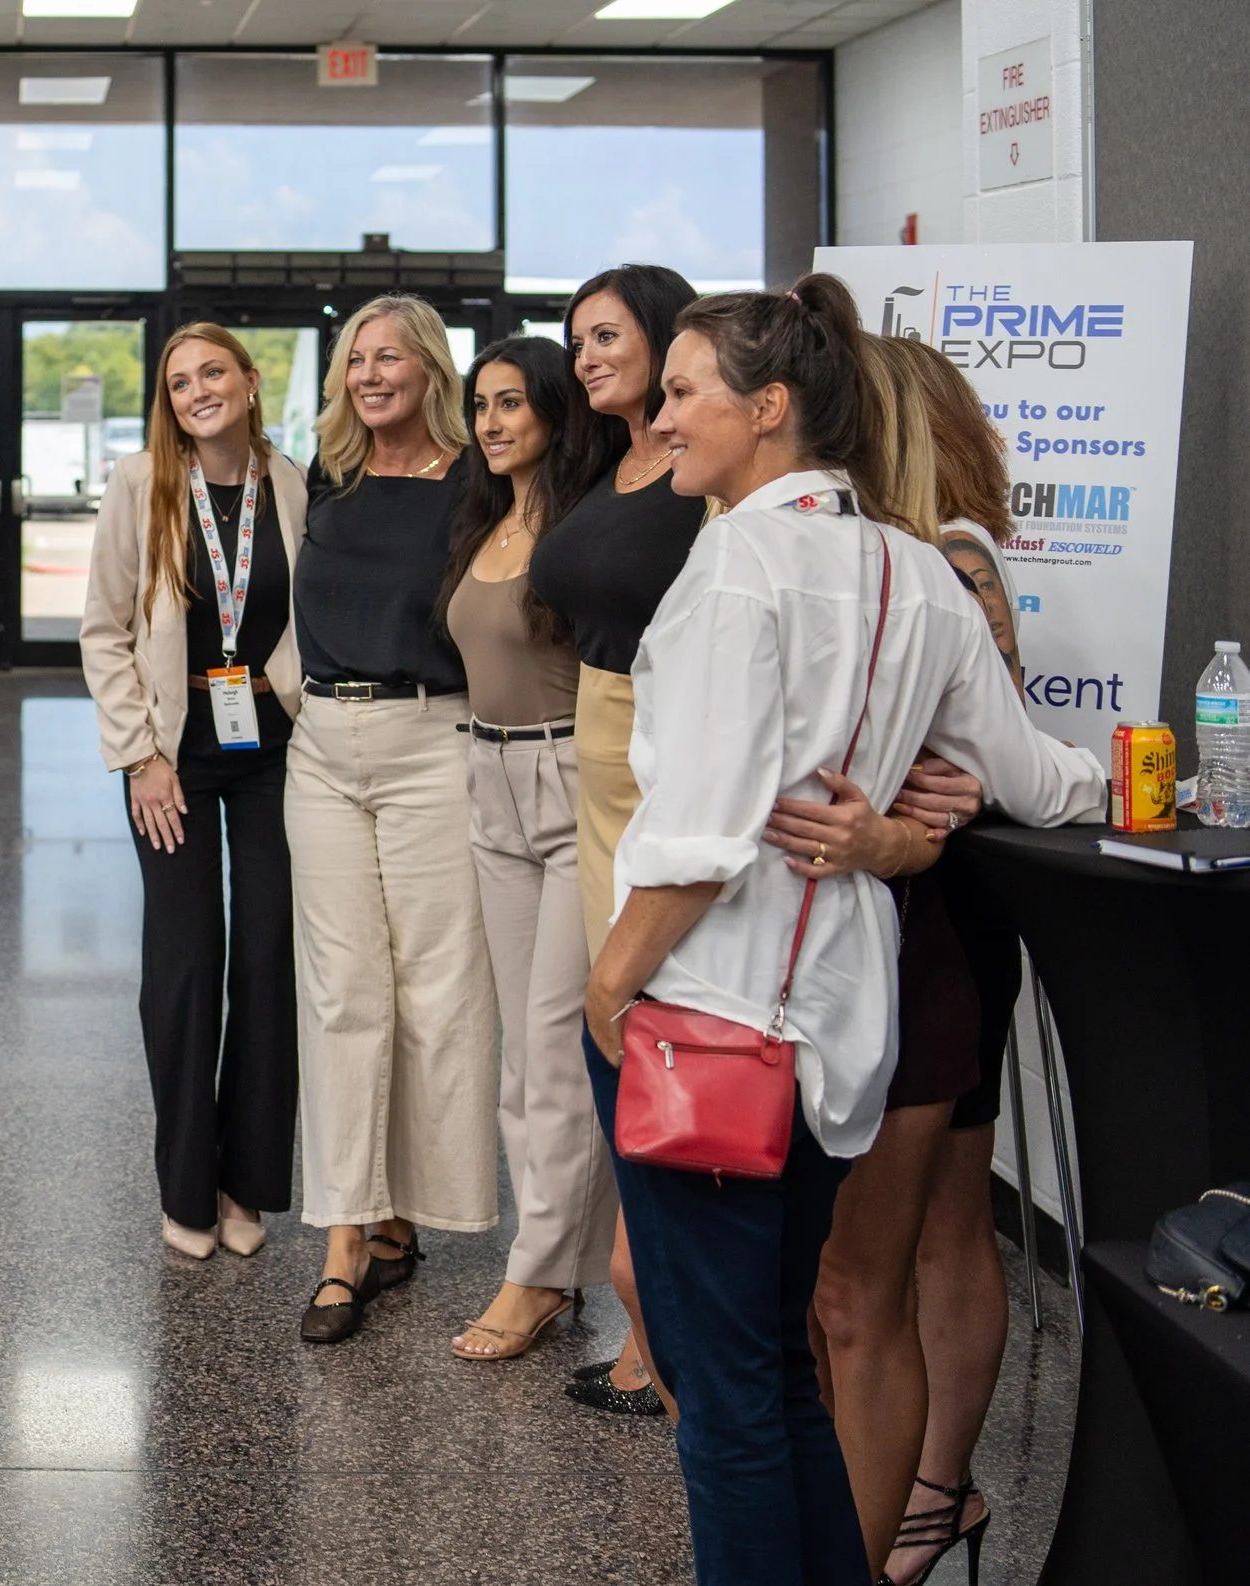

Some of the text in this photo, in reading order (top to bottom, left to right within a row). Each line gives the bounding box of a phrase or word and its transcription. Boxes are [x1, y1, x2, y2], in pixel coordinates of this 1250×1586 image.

[327, 48, 368, 79] EXIT
[1003, 63, 1024, 90] FIRE
[980, 96, 1051, 135] EXTINGUISHER
[946, 285, 1012, 302] THE
[942, 304, 1125, 338] PRIME
[941, 340, 1087, 370] EXPO
[1018, 400, 1047, 420] to
[1056, 404, 1105, 421] our
[1016, 431, 1146, 462] Sponsors
[1011, 482, 1131, 521] CHMAR
[1026, 520, 1083, 533] FOUNDATION
[1084, 522, 1128, 535] SYSTEMS
[1000, 535, 1123, 556] kfast ESCOWELD
